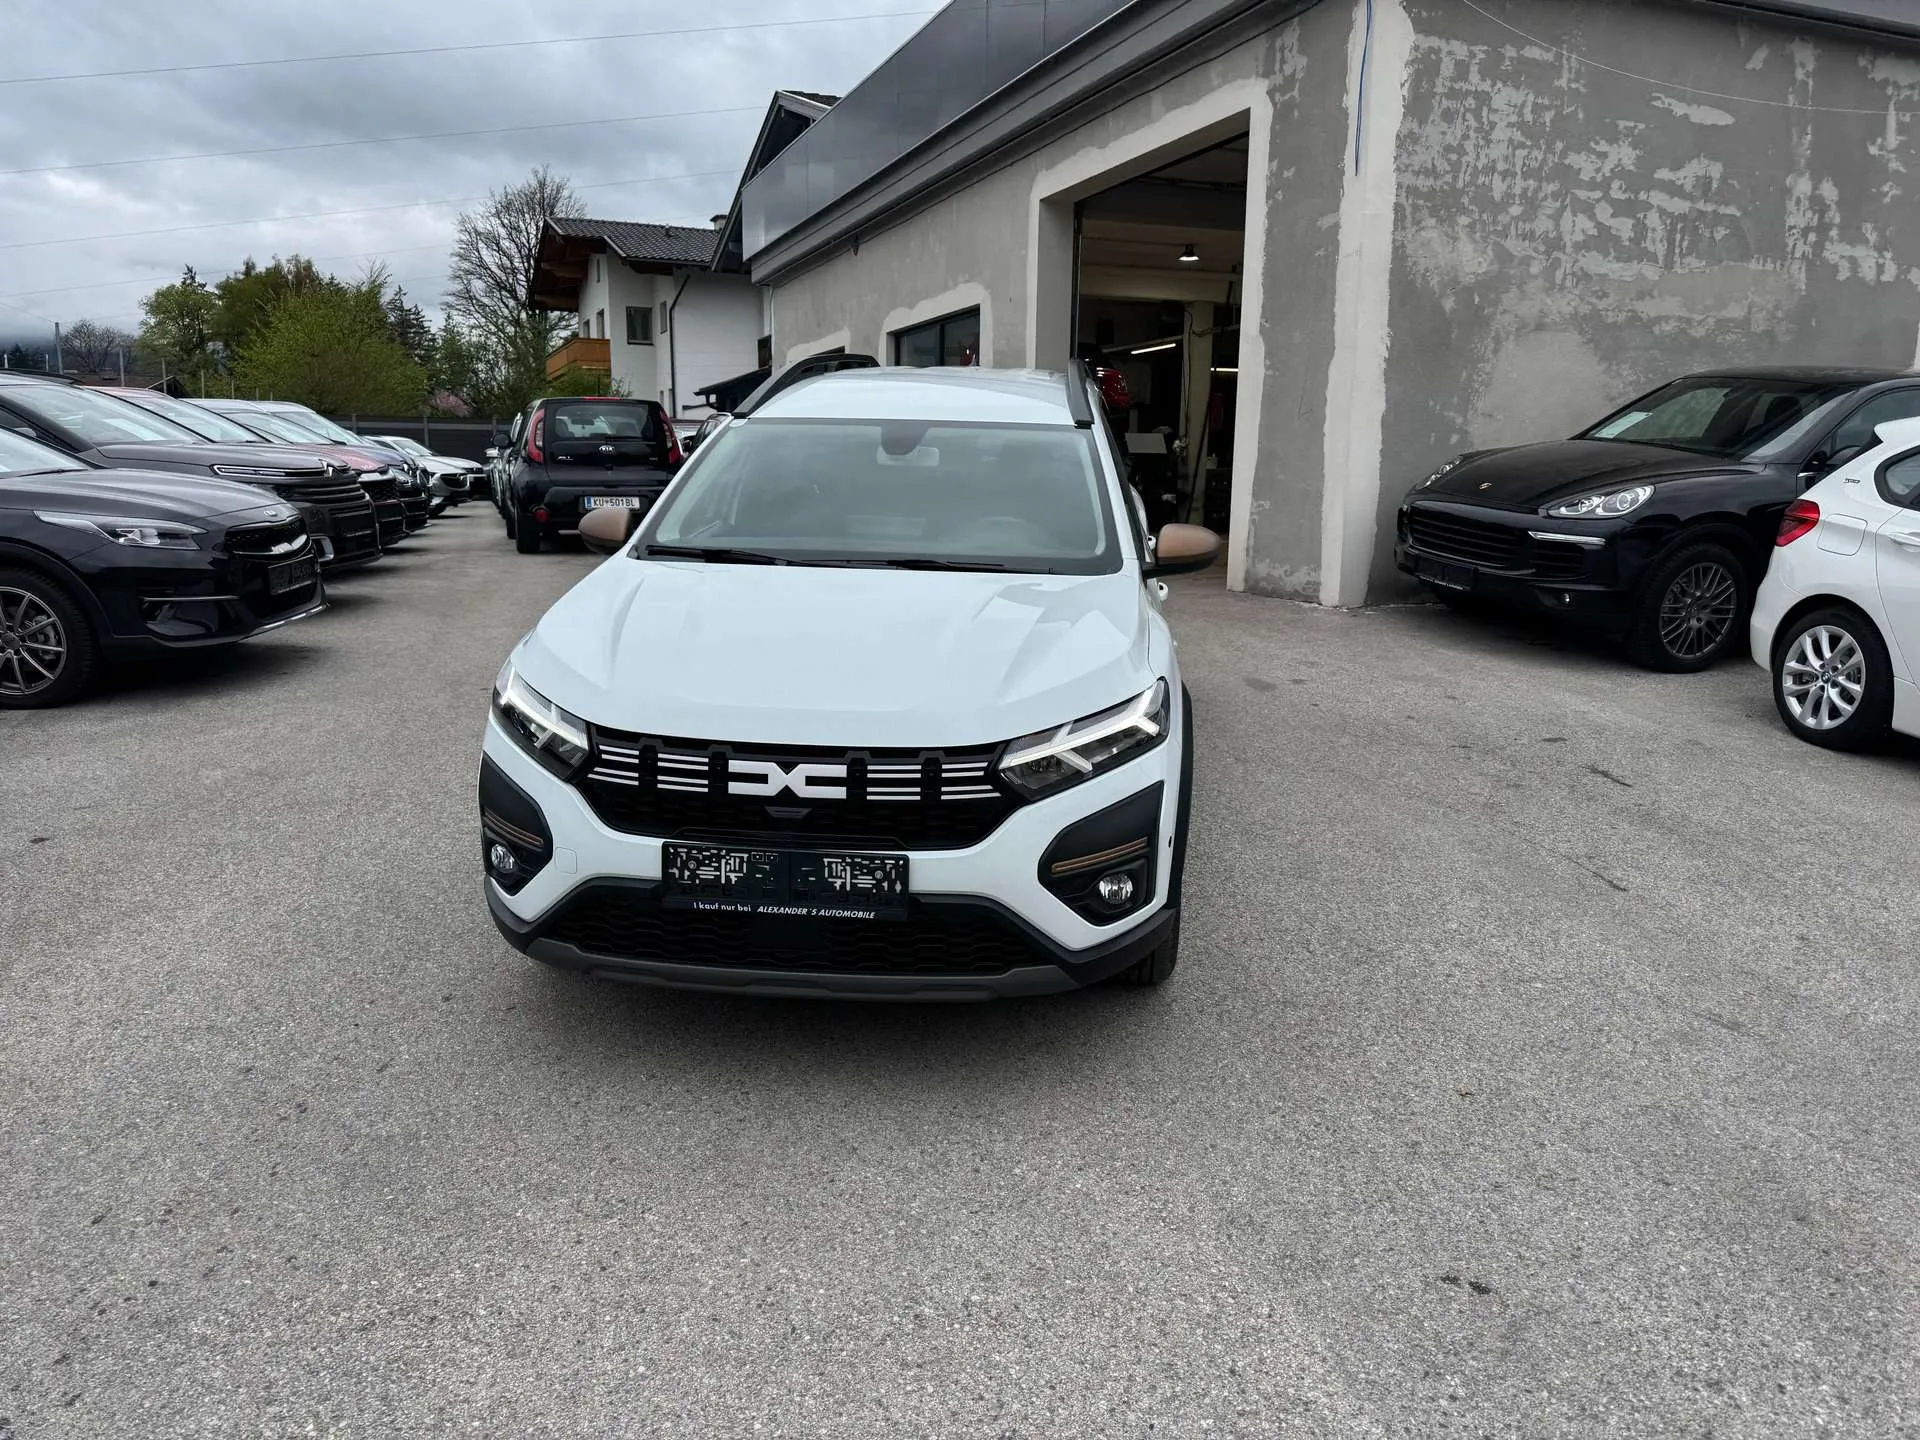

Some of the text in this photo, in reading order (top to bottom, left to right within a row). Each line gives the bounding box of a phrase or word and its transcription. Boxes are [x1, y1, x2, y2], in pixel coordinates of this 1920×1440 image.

[698, 902, 719, 910] kauf
[737, 904, 752, 912] bei
[818, 909, 876, 919] AUTOMOBILE
